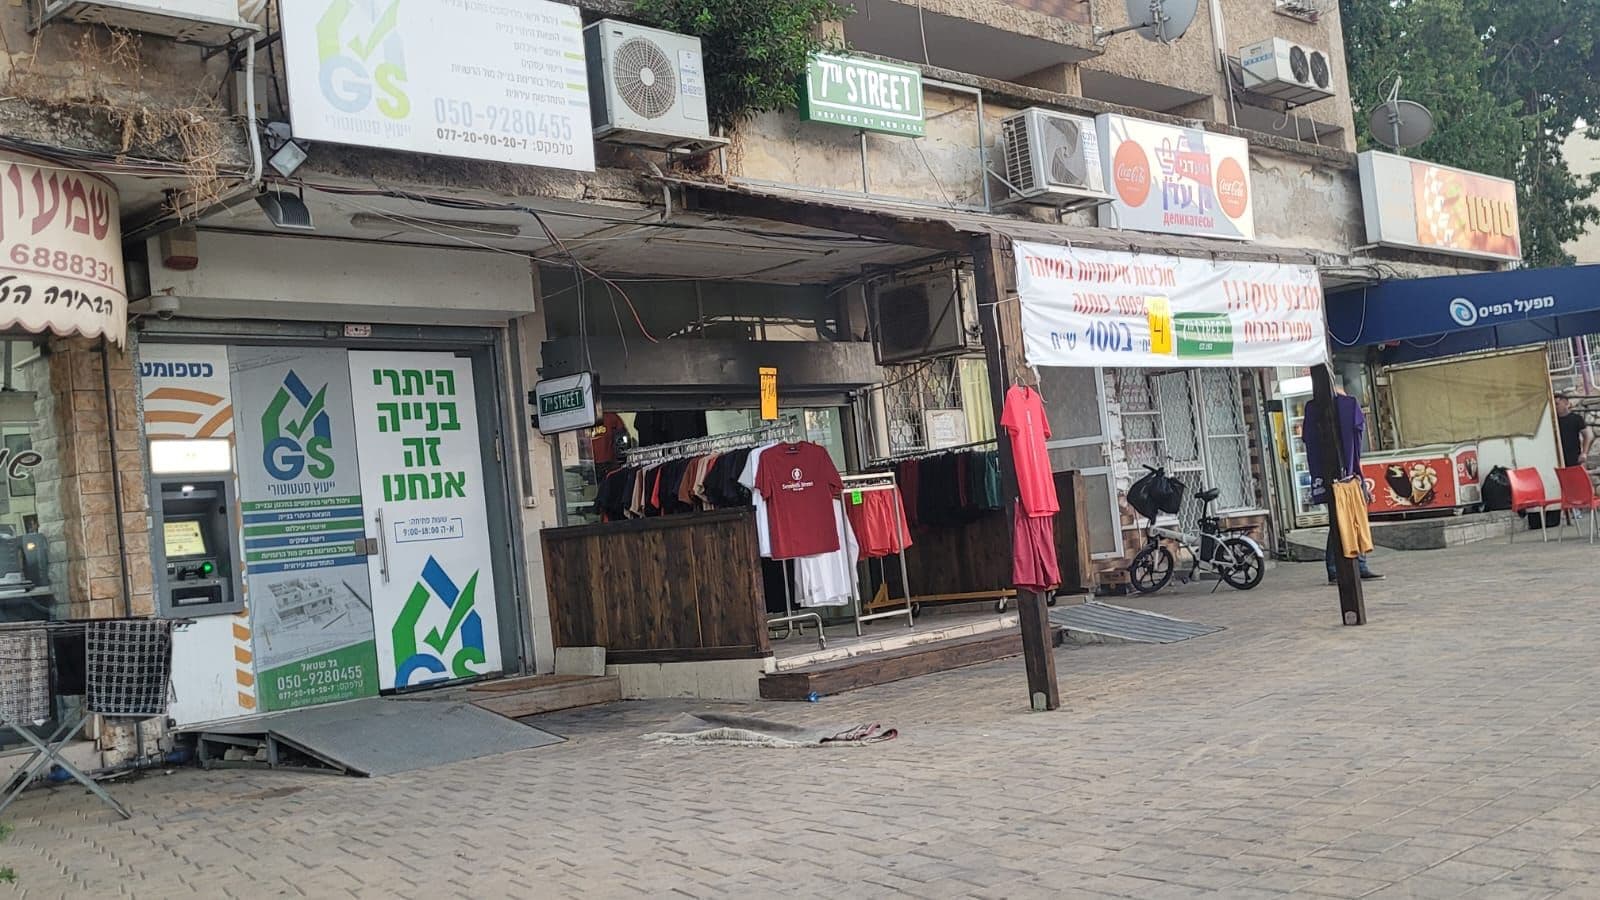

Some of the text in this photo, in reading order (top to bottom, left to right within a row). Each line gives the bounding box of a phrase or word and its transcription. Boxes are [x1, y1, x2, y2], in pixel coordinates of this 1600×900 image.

[320, 56, 411, 121] GS
[846, 66, 911, 112] STREET
[435, 97, 572, 141] 050-9280455
[437, 128, 527, 149] 077-20-90-20-7
[10, 244, 114, 285] 6888331
[1479, 296, 1555, 318] מפעל הפיס
[140, 362, 213, 377] כספומט
[373, 369, 456, 397] היתרי
[554, 391, 580, 410] STREET
[376, 402, 460, 432] בנייה
[263, 436, 334, 481] GS
[402, 437, 441, 467] זה
[382, 472, 466, 502] אנחנו
[277, 665, 362, 690] 050-9280455
